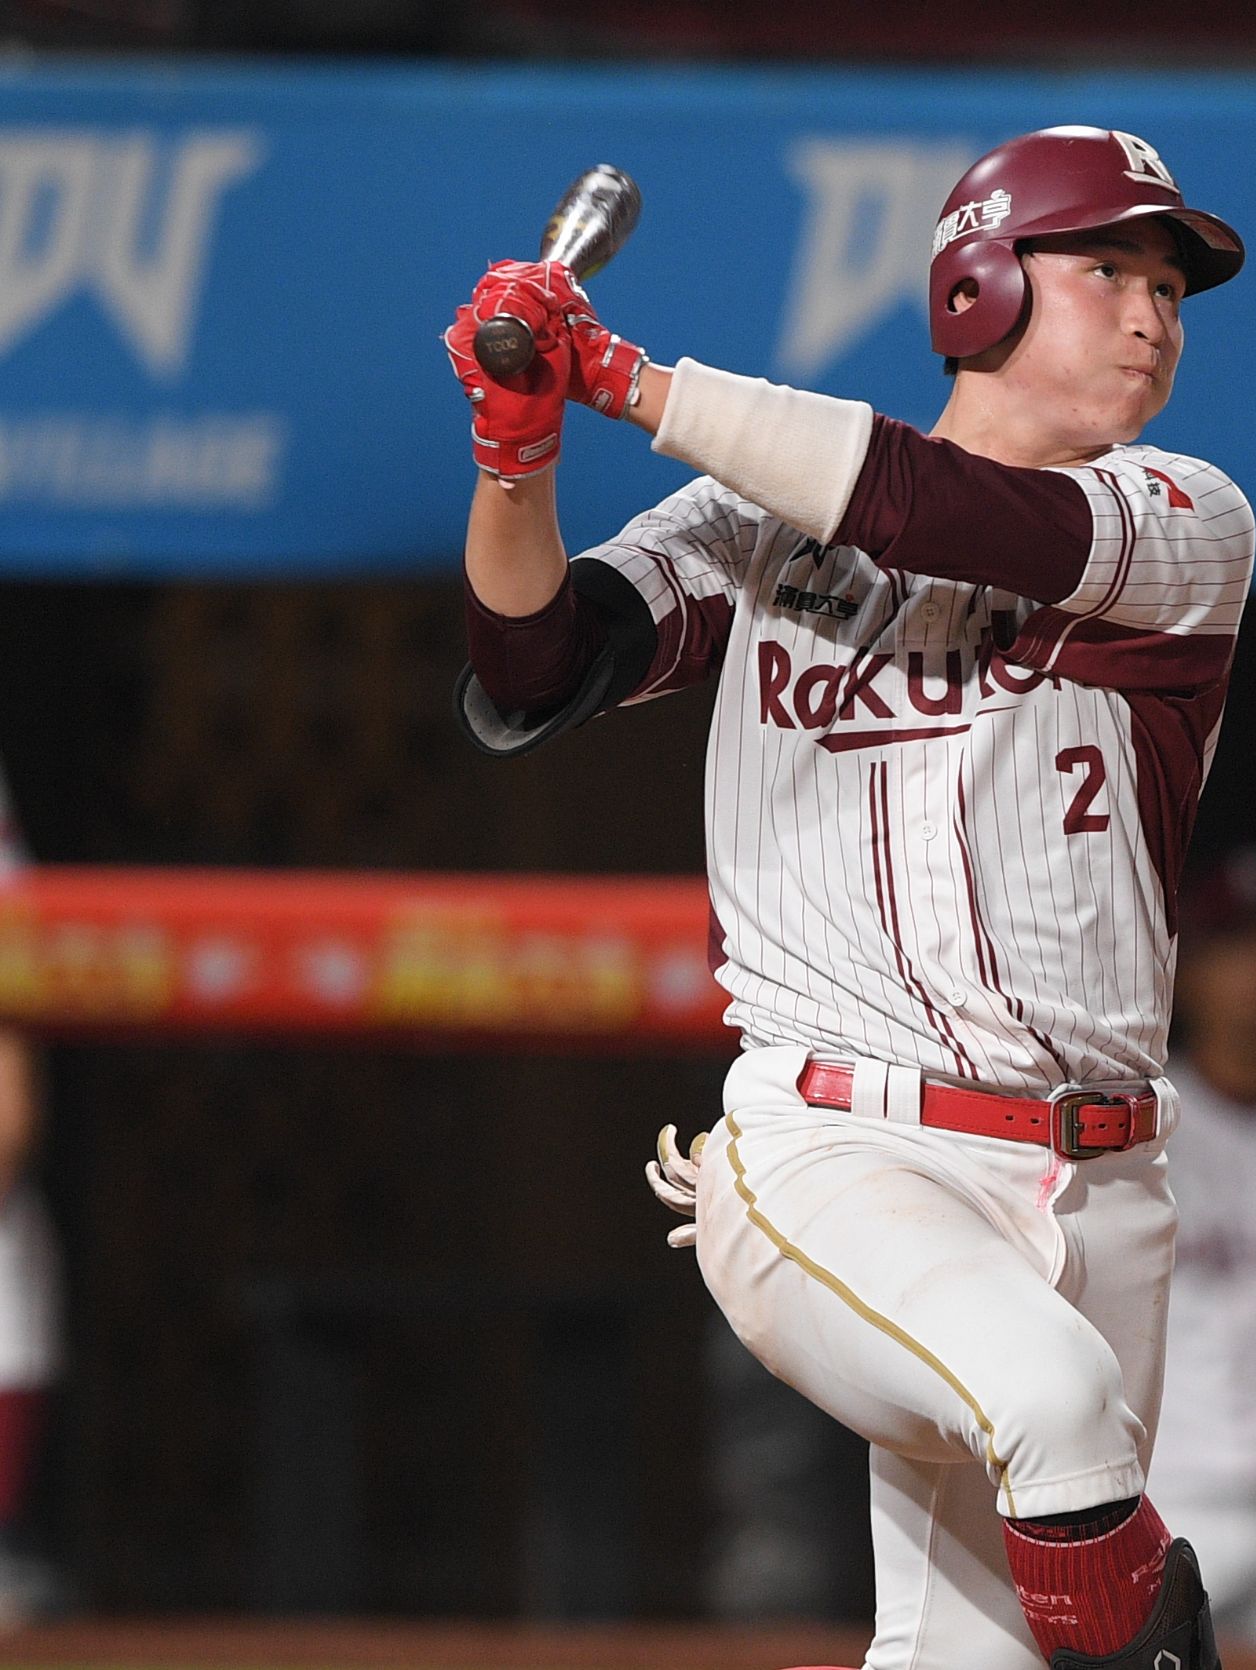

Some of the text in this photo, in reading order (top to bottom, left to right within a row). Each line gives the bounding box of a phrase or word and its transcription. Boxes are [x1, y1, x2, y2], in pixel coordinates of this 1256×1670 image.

[1111, 130, 1180, 195] R
[758, 627, 1063, 731] Rakute
[1055, 744, 1111, 836] 2
